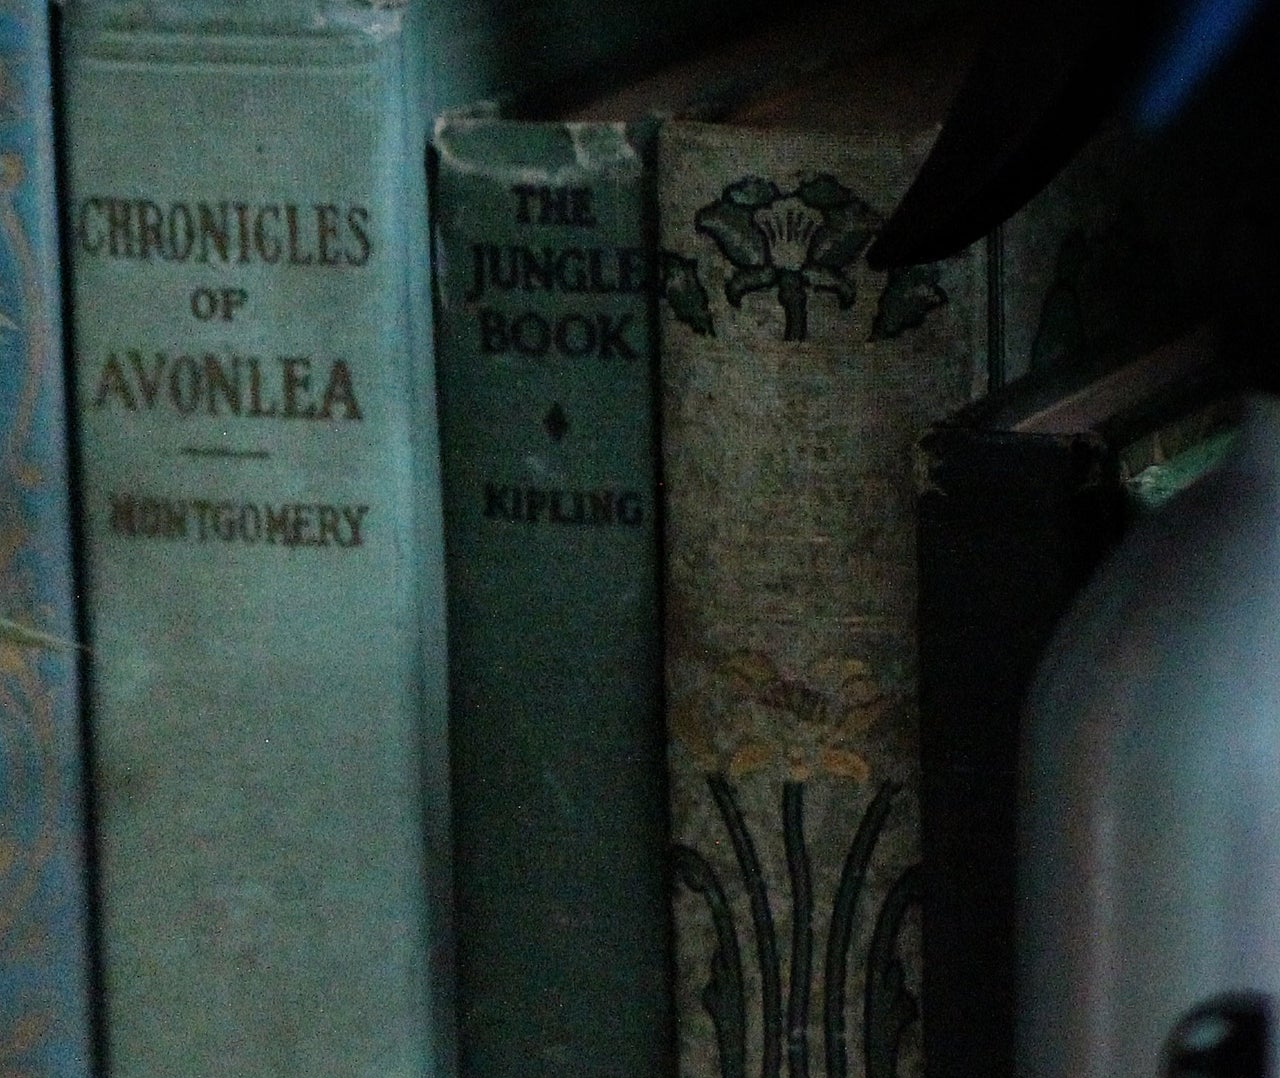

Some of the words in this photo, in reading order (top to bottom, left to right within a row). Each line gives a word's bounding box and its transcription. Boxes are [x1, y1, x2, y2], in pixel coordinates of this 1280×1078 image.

[79, 196, 373, 269] CHRONICLES
[511, 183, 598, 229] THE
[467, 243, 653, 303] JUNGLE
[190, 287, 249, 323] OF
[478, 308, 641, 361] BOOK
[94, 348, 363, 422] AVONLEA
[109, 490, 371, 549] MONTGOMERY
[484, 482, 644, 527] KIPLING
